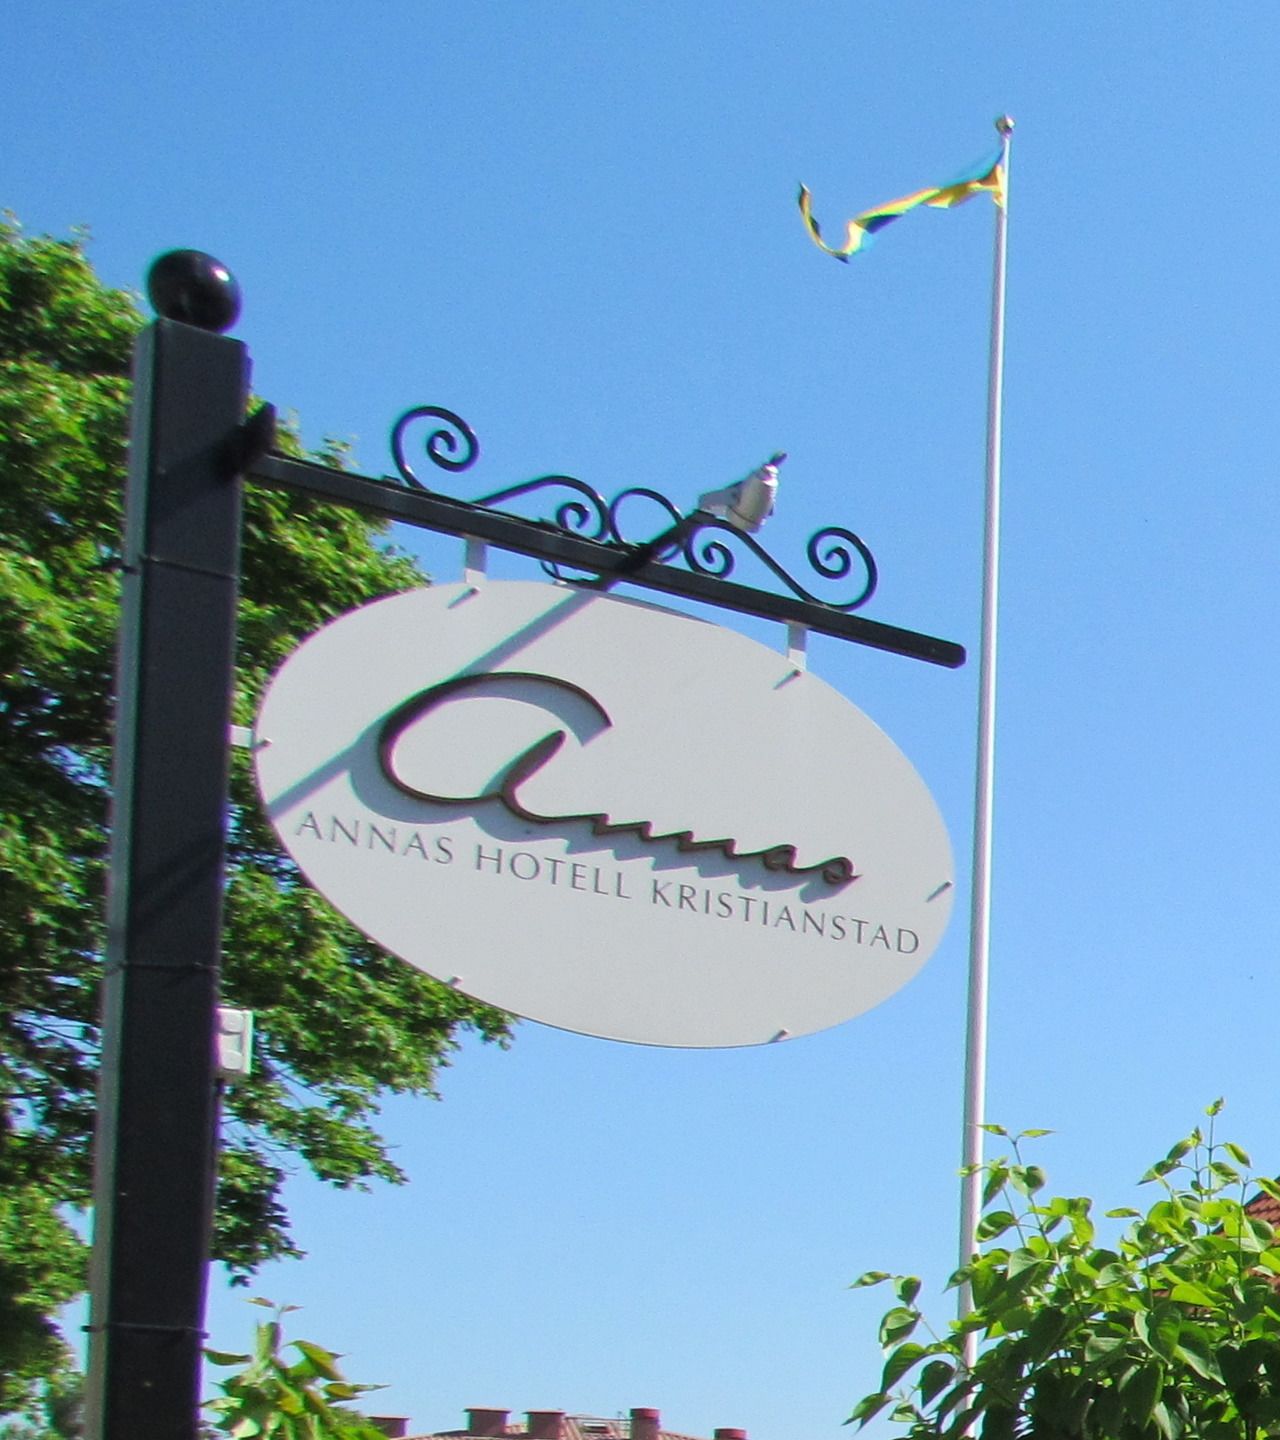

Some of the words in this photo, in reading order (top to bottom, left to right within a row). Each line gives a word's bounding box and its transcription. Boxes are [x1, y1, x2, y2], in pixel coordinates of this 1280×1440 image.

[295, 811, 454, 865] ANNAS
[475, 844, 632, 899] HOTELL
[651, 878, 920, 954] KRISTIANSTAD
